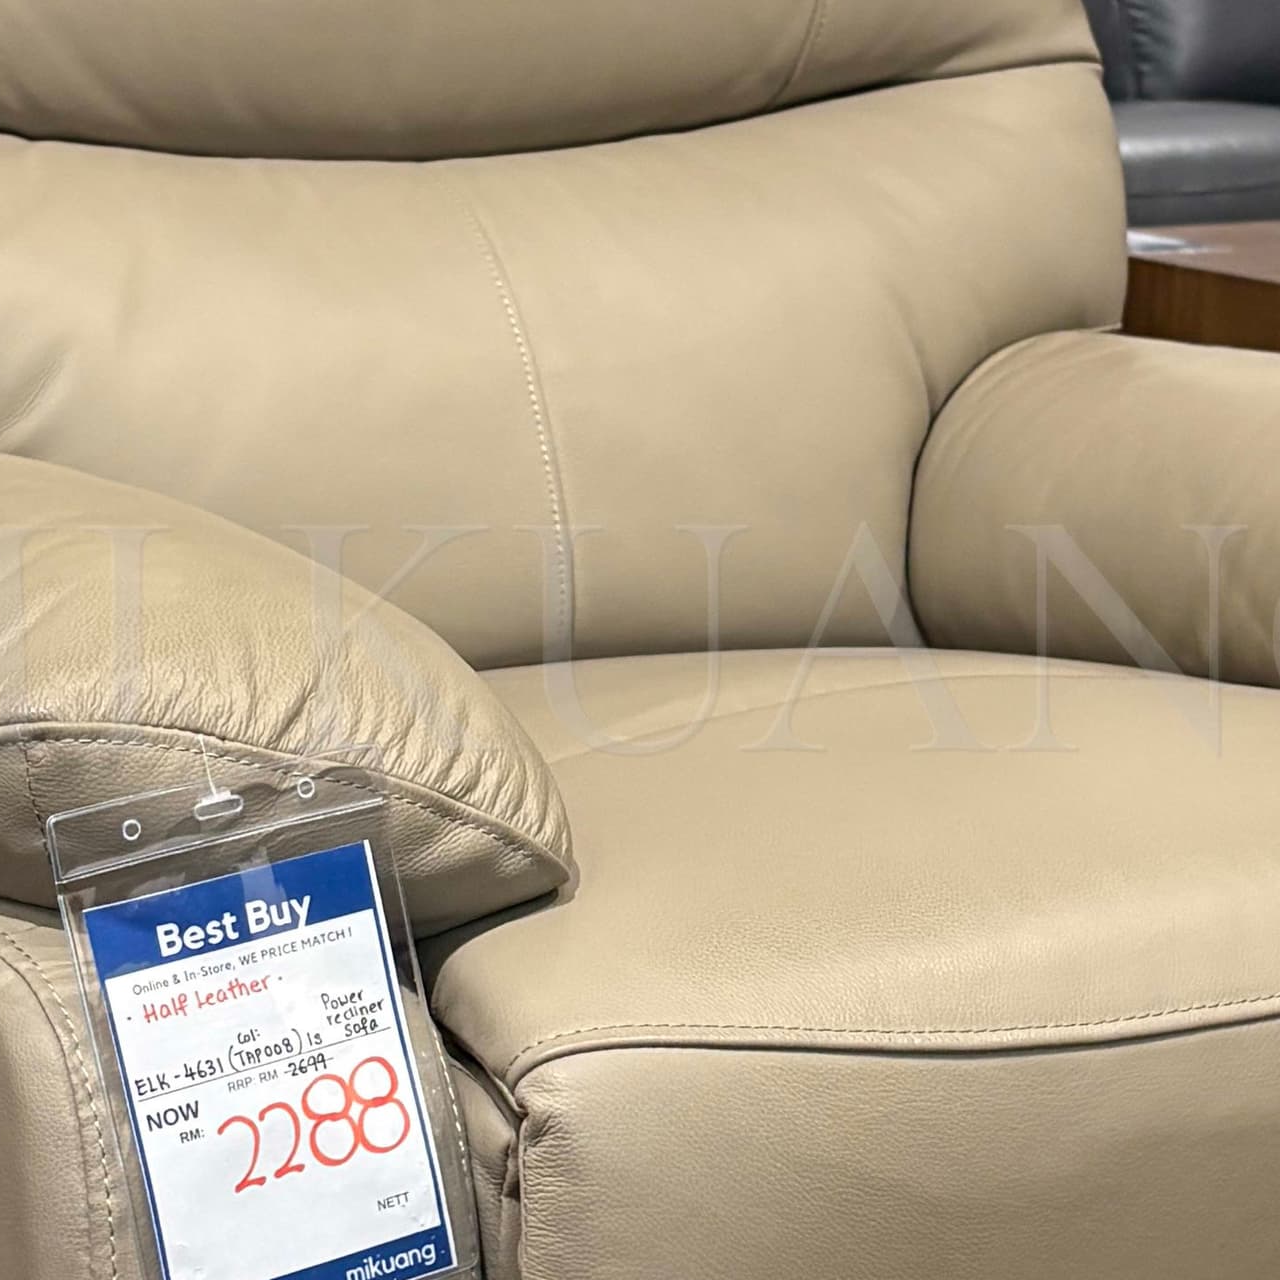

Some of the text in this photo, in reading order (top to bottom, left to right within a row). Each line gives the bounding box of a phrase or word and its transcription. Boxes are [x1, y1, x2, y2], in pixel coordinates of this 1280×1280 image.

[156, 895, 311, 957] Best Buy
[132, 978, 169, 996] Online
[173, 973, 181, 985] &
[184, 961, 236, 983] In-Store,
[238, 952, 258, 967] WE
[261, 941, 297, 960] PRICE
[143, 994, 187, 1024] Half
[321, 989, 364, 1011] Power
[259, 1070, 278, 1083] RM
[146, 1100, 200, 1132] NOW
[180, 1056, 410, 1193] RM: 2288
[377, 1191, 410, 1211] NETT
